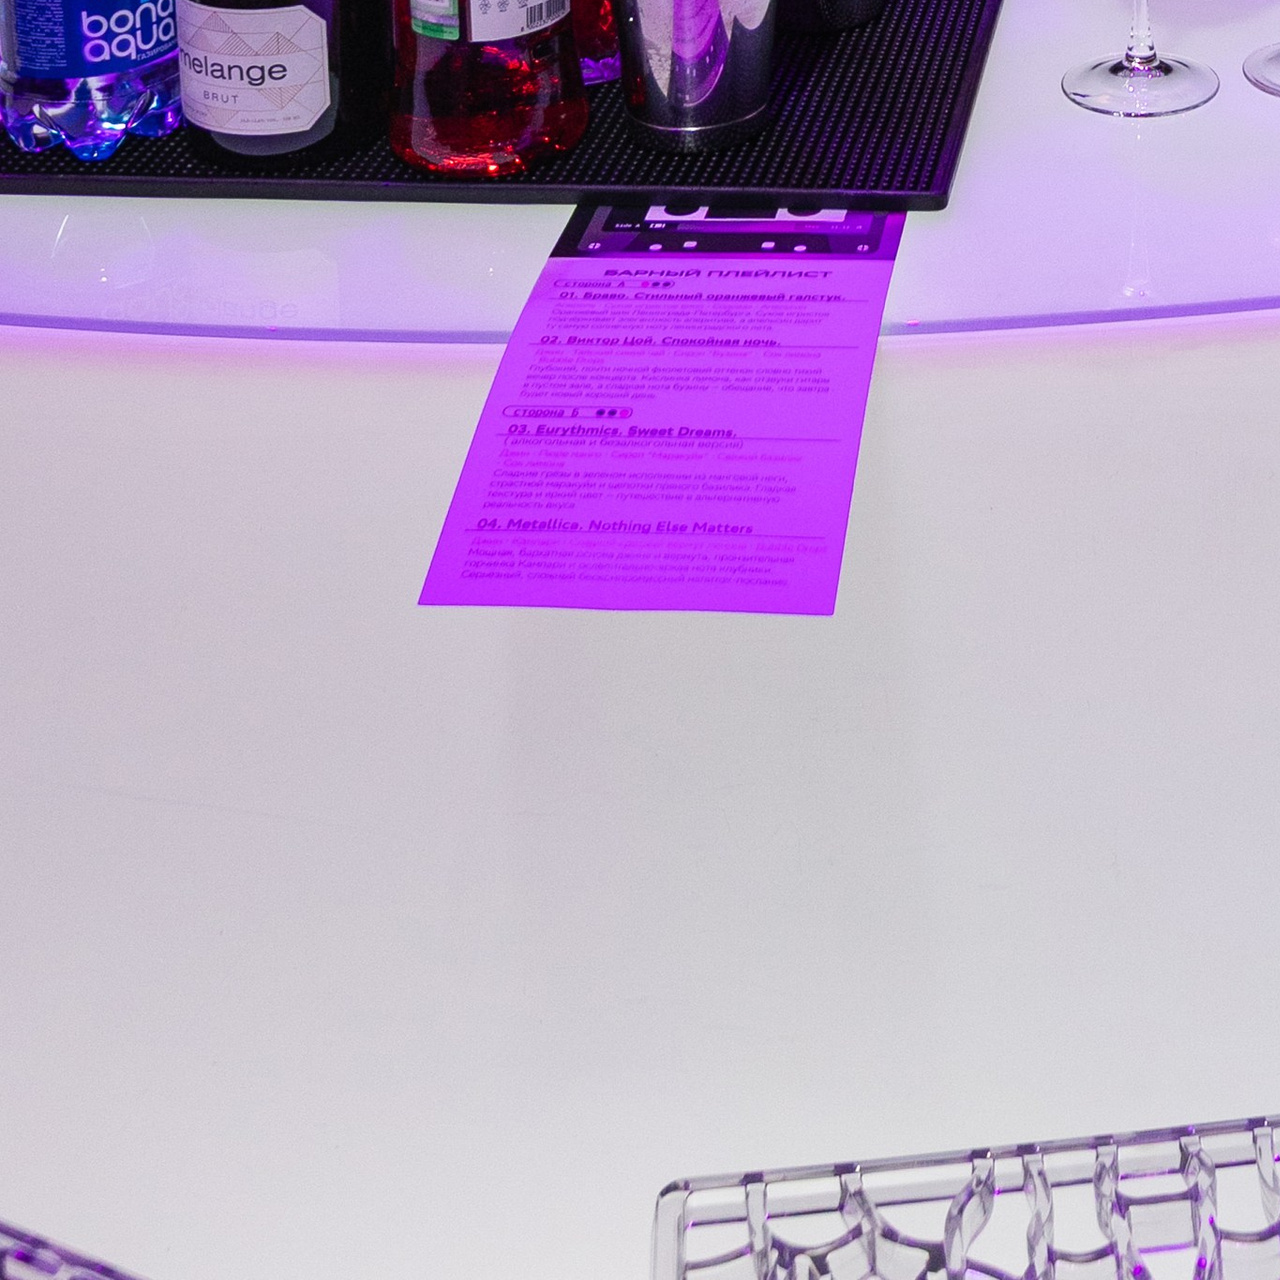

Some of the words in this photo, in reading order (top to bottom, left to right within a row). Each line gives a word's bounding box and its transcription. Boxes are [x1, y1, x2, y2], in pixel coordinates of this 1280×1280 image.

[84, 17, 175, 63] aqua
[180, 48, 288, 86] melange
[203, 90, 239, 104] BRUT
[604, 268, 701, 278] БАРНЫЙ
[707, 268, 834, 279] ПЛЕЙЛИСТ
[559, 291, 579, 300] 01.
[582, 291, 631, 301] Браво.
[634, 291, 703, 301] Стильный
[705, 292, 785, 302] оранжевый
[788, 294, 848, 303] галстук.
[541, 334, 563, 345] 02.
[567, 334, 621, 346] Виктор
[625, 334, 658, 347] Цой.
[662, 335, 742, 347] Спокойная
[744, 337, 781, 347] ночь.
[513, 408, 565, 419] сторона
[507, 422, 532, 434] 03.
[535, 422, 624, 438] Eurythmics.
[627, 424, 676, 437] Sweet
[677, 425, 738, 440] Dreams.
[476, 517, 503, 530] 04.
[506, 517, 584, 532] Metallica.
[588, 519, 652, 535] Nothing
[656, 521, 688, 534] Else
[692, 521, 754, 535] Matters
